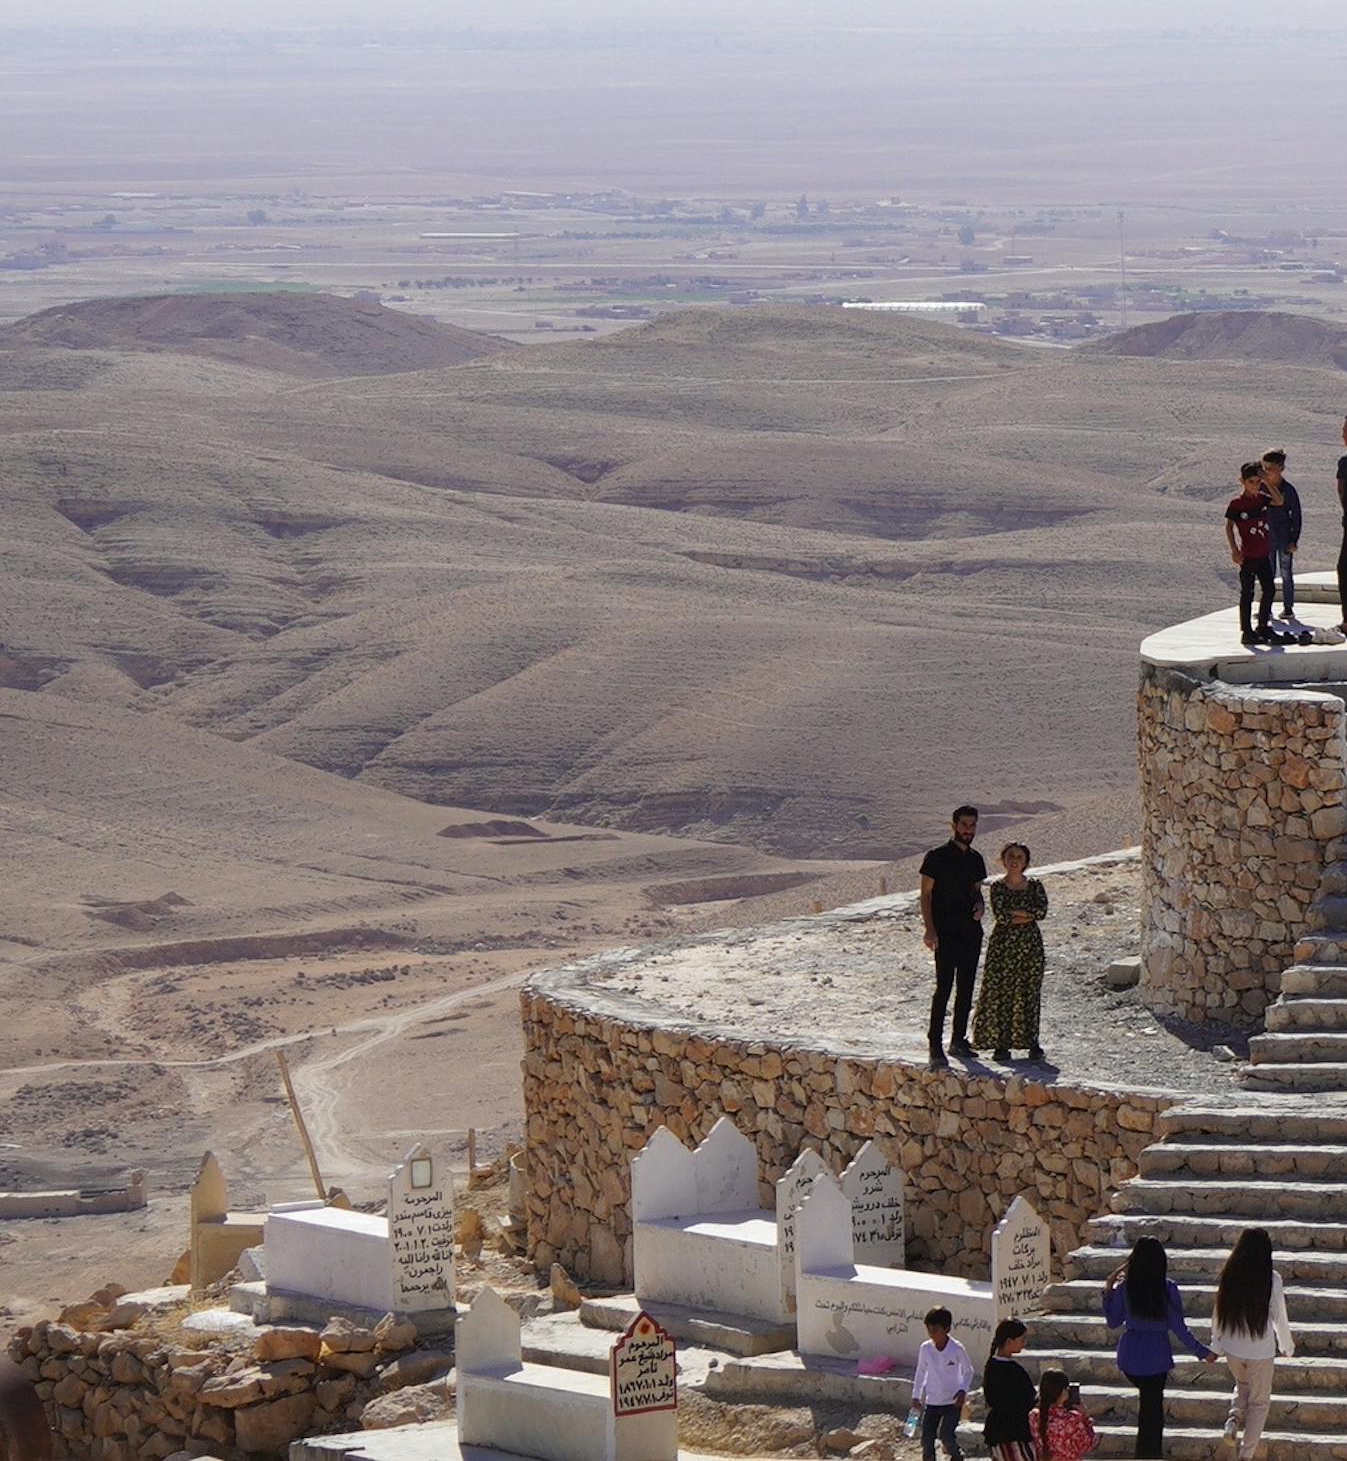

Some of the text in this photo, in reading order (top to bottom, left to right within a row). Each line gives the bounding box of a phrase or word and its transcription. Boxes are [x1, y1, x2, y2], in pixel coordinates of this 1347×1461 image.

[860, 1166, 891, 1182] المرحوم
[403, 1191, 443, 1207] المرحومة
[881, 1197, 901, 1208] خلف
[412, 1207, 432, 1223] قاسم
[889, 1211, 902, 1224] ولد
[417, 1226, 424, 1236] ٧
[432, 1221, 453, 1233] ولدت
[431, 1234, 453, 1248] توفيت
[1012, 1243, 1035, 1257] بركات
[1027, 1256, 1040, 1269] مراد
[408, 1263, 443, 1278] راجعون
[1037, 1271, 1048, 1283] ولد
[431, 1277, 448, 1291] الله
[628, 1335, 663, 1354] المرحوم
[638, 1348, 656, 1366] شيخ
[657, 1349, 673, 1361] مراد
[636, 1359, 658, 1378] ناصر
[657, 1373, 673, 1387] ولد
